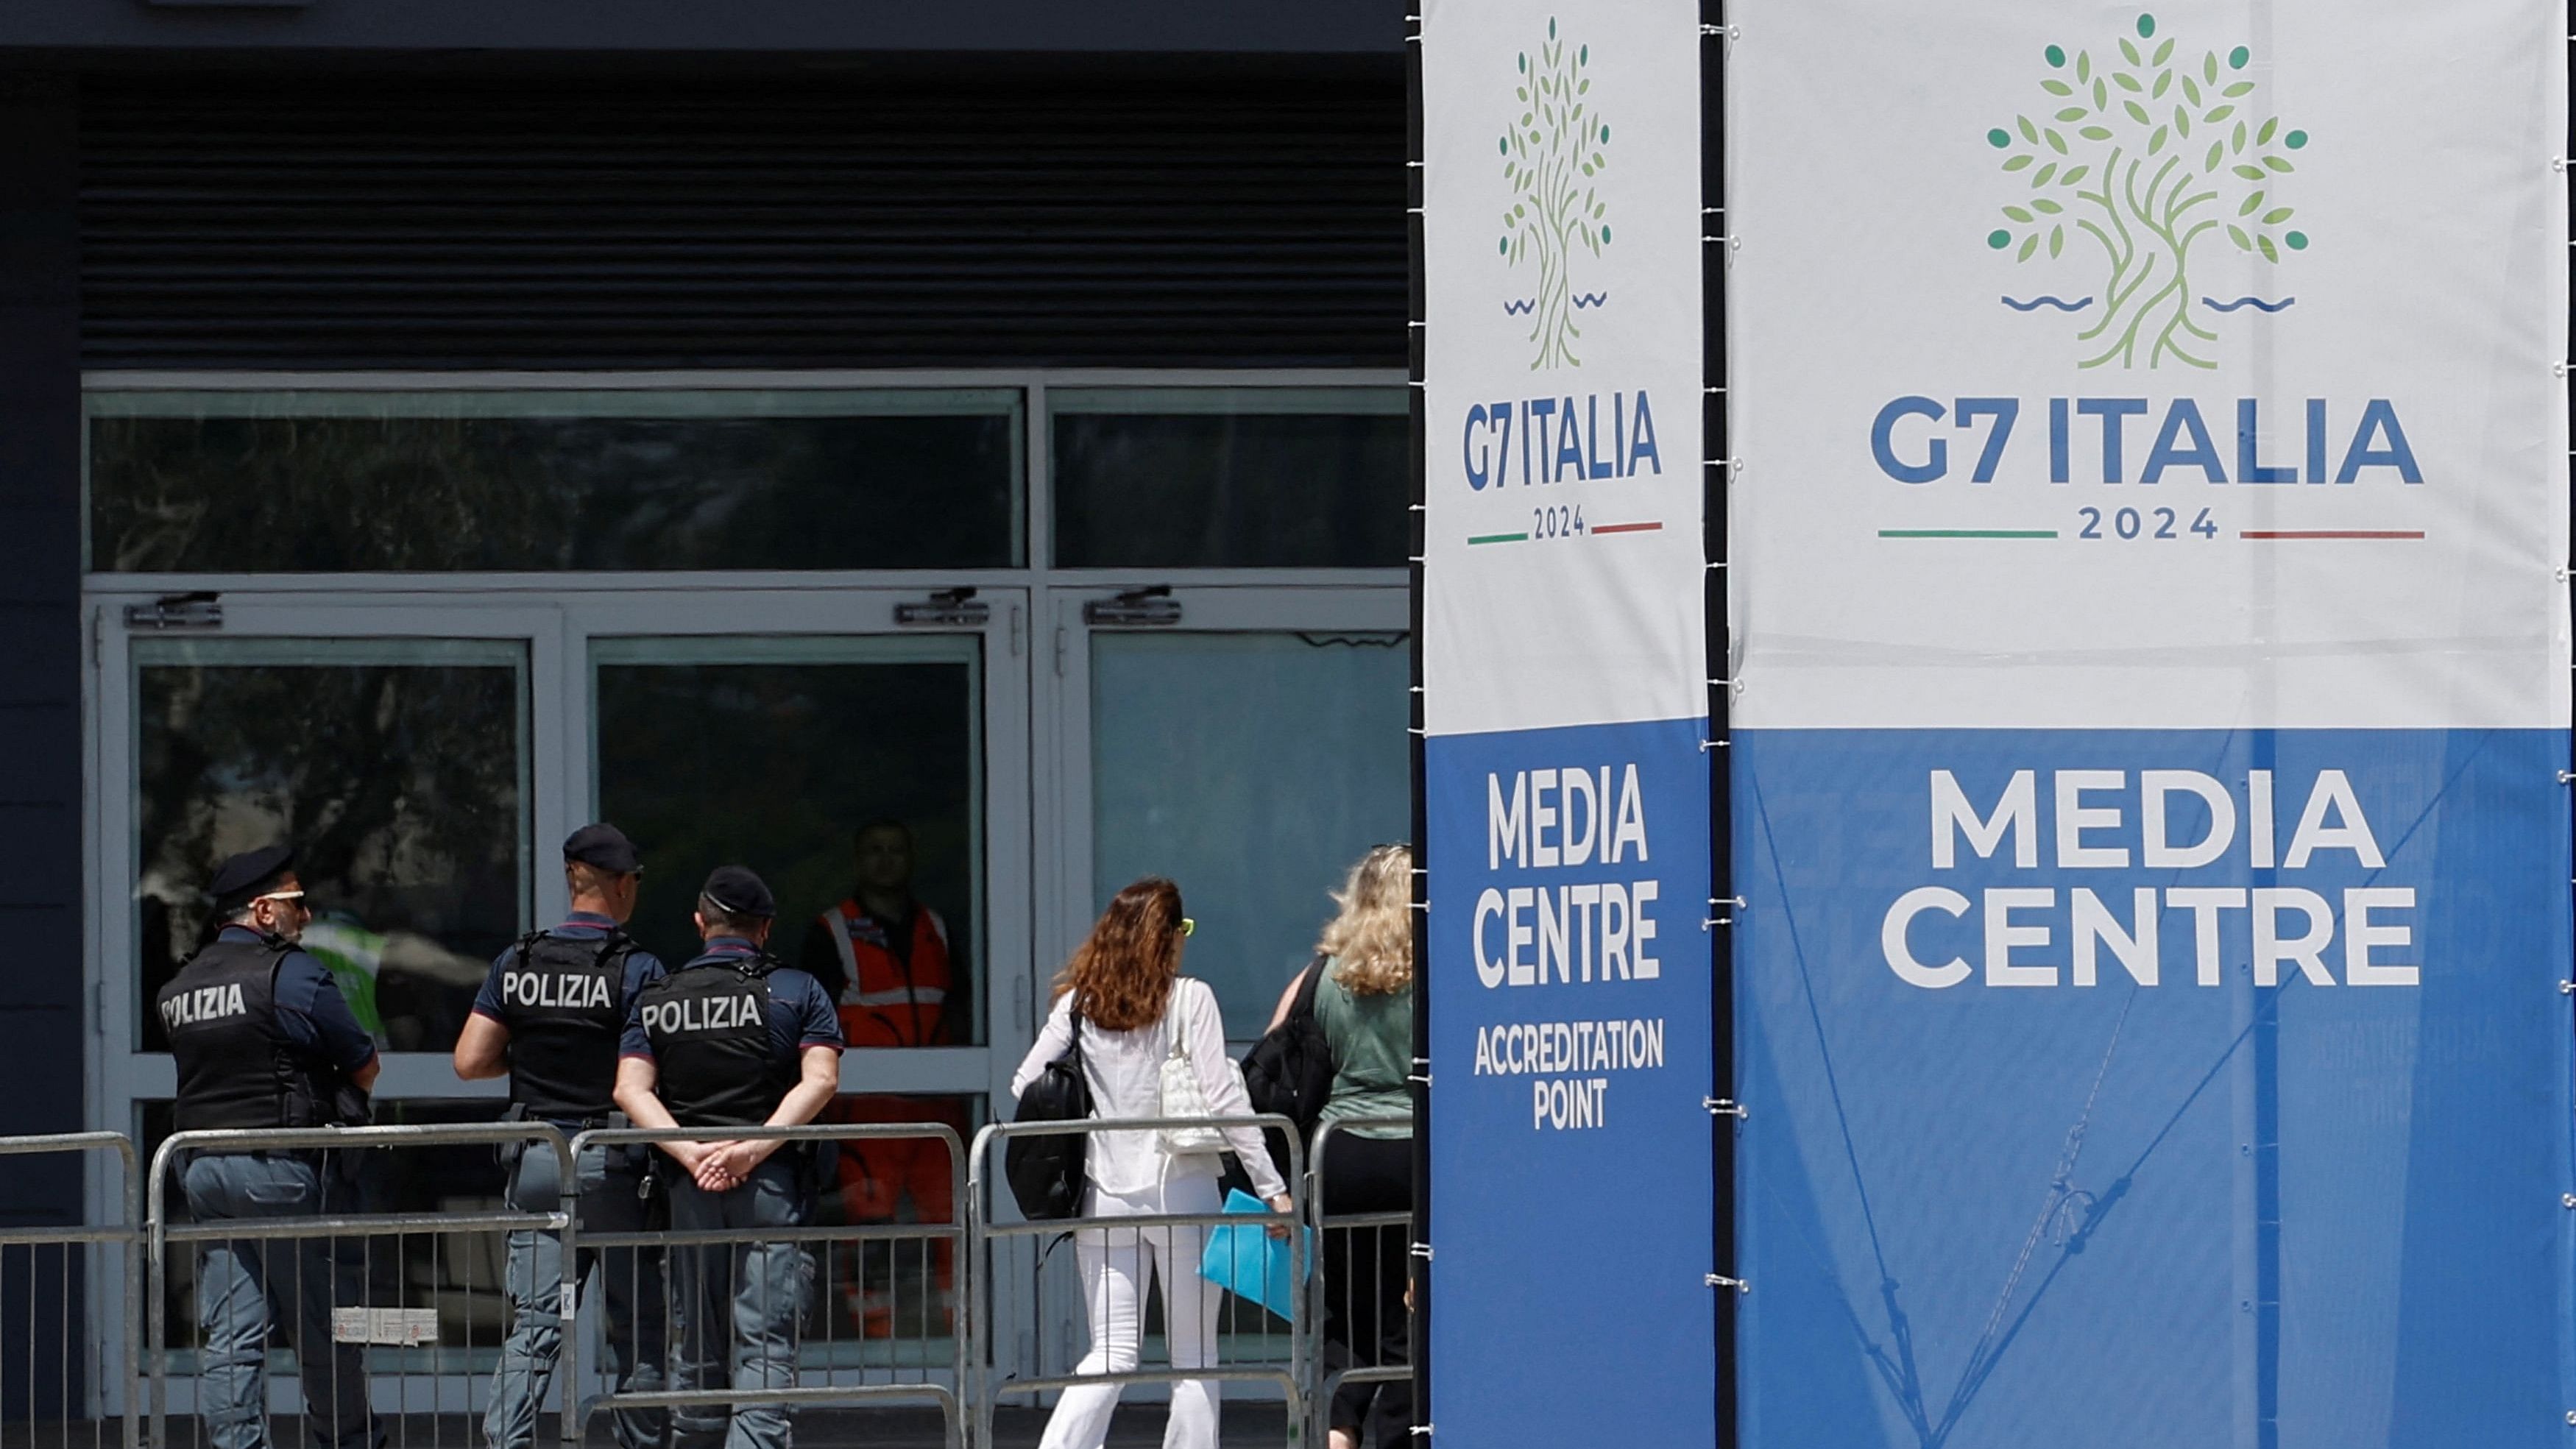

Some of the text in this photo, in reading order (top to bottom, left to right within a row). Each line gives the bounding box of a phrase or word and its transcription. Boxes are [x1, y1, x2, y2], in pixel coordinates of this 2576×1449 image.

[1464, 390, 1661, 491] G7 ITALIA
[1871, 396, 2424, 484] G7 ITALIA
[1533, 505, 1585, 539] 2024
[2078, 507, 2218, 539] 2024
[1488, 763, 1648, 871] MEDIA
[1930, 769, 2387, 868] MEDIA
[1473, 879, 1660, 989] CENTRE
[1881, 886, 2420, 989] CENTRE
[160, 982, 247, 1033] POLIZIA
[502, 971, 612, 1009] POLIZIA
[641, 994, 763, 1038] POLIZIA
[1474, 1018, 1664, 1076] ACCREDITATION
[1534, 1078, 1608, 1130] POINT
